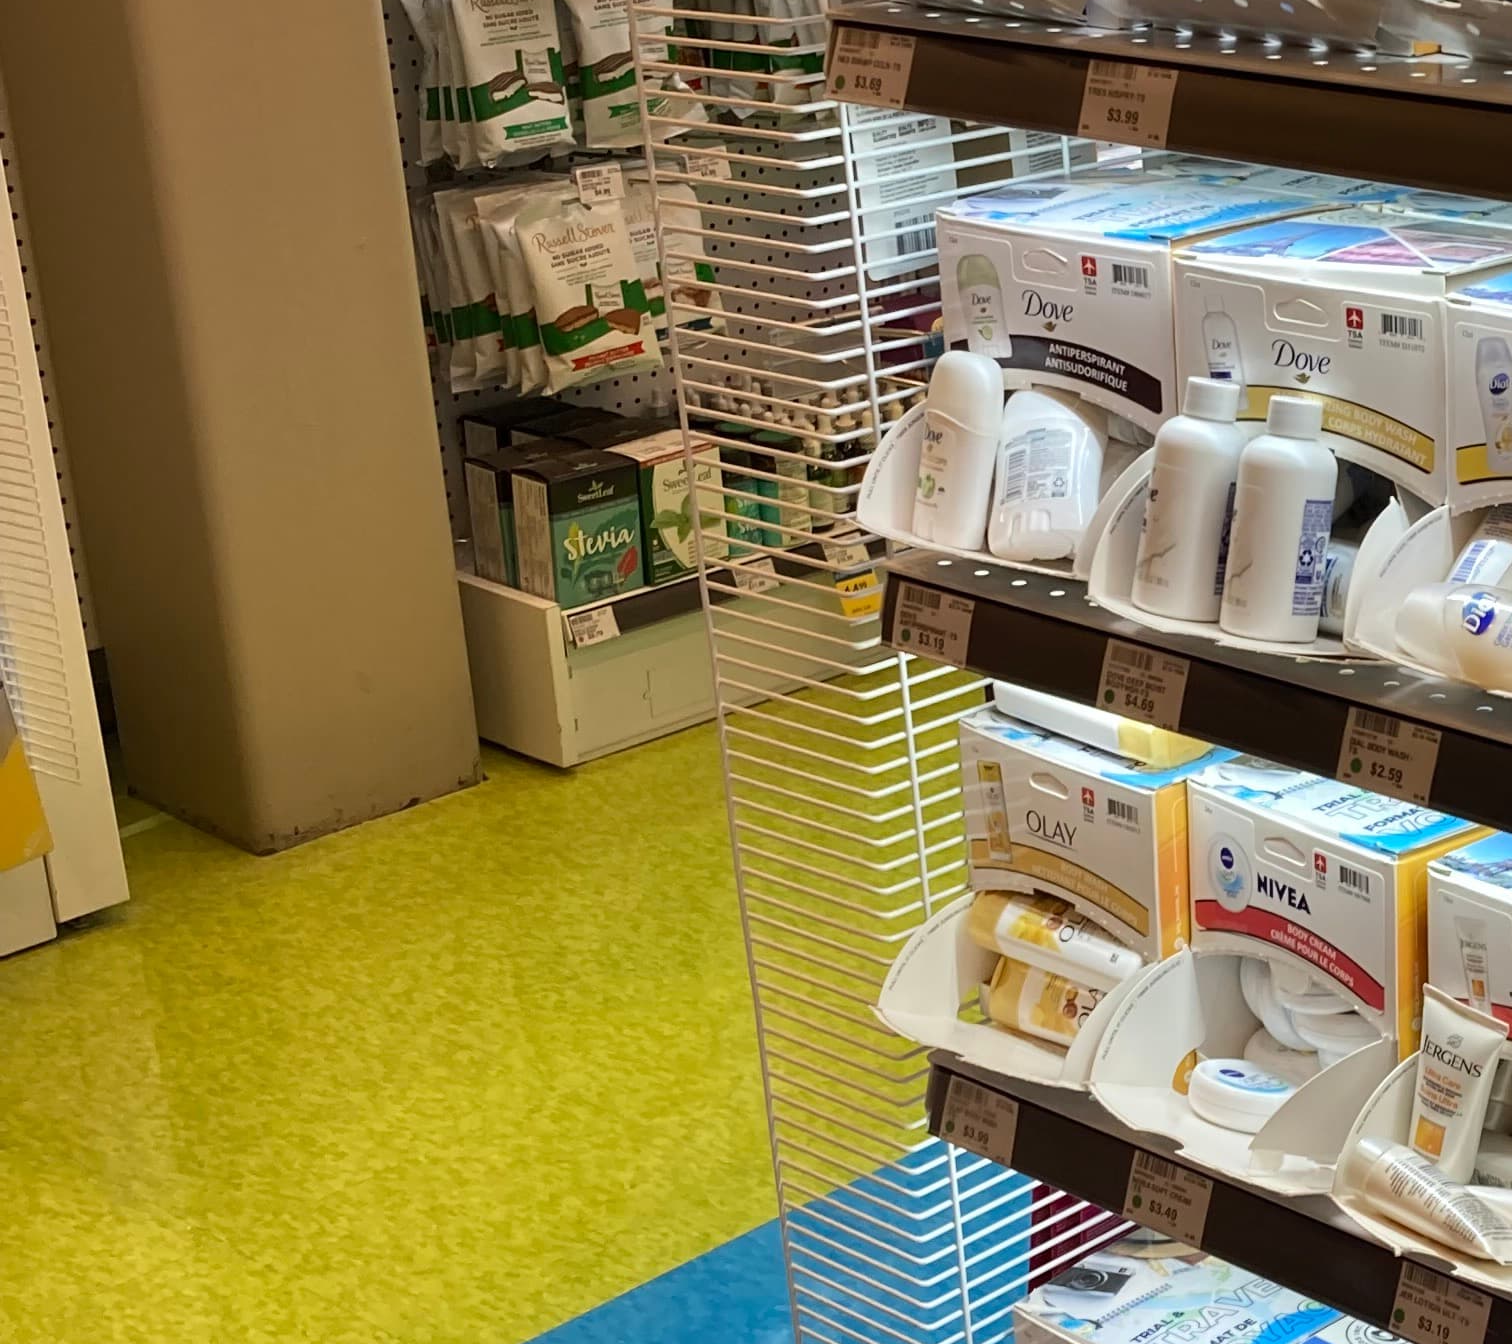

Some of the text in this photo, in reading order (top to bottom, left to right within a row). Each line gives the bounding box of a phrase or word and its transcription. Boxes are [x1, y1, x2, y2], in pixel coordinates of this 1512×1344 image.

[854, 74, 882, 91] $3.69
[1106, 108, 1139, 125] $3.99
[531, 222, 615, 254] Russell Stover
[1021, 290, 1073, 323] Dove
[1049, 343, 1126, 376] ANTIPERSPIRANT
[1271, 339, 1331, 374] Dove
[1045, 357, 1128, 392] ANTISUDORIFIQUE
[1328, 415, 1426, 466] CORPS HYDRATANT
[1353, 408, 1417, 444] BODY WASH
[563, 525, 635, 561] stevia
[1125, 694, 1154, 712] $4.69
[1370, 762, 1403, 783] $2.59
[1026, 810, 1077, 846] OLAY
[1257, 872, 1311, 915] NIVEA
[1270, 929, 1354, 988] CRÈME POUR LE CORPS
[1287, 924, 1336, 960] BODY CREAM
[1421, 1034, 1483, 1079] JERGENS
[962, 1124, 989, 1145] $3.99
[1148, 1199, 1178, 1221] $3.49
[1130, 1311, 1185, 1344] TRIAL &
[1232, 1318, 1256, 1339] DE
[1418, 1316, 1450, 1340] $3.19
